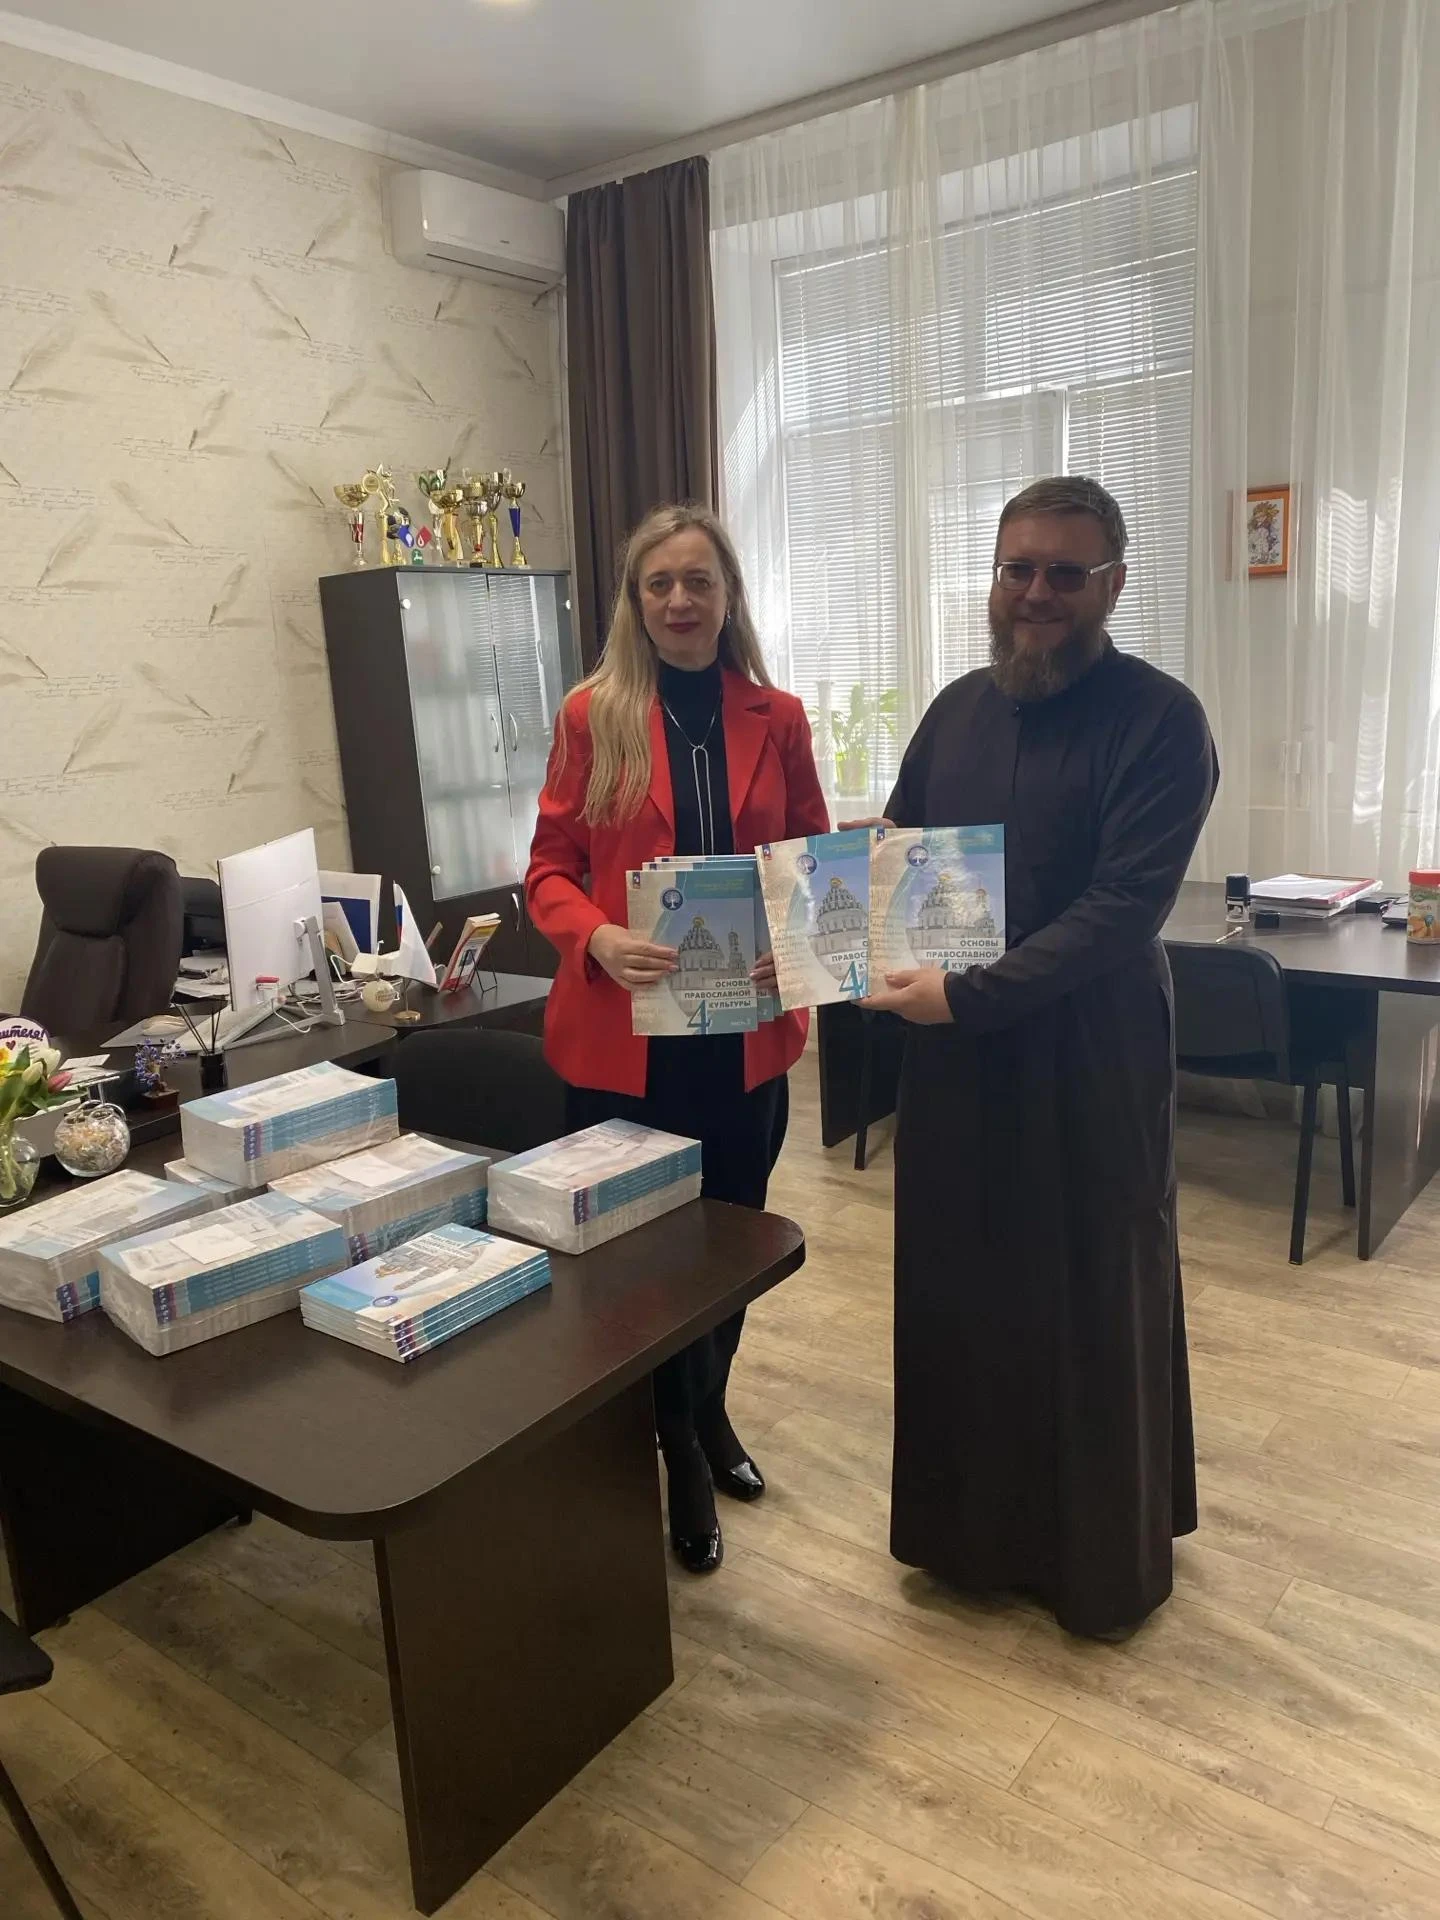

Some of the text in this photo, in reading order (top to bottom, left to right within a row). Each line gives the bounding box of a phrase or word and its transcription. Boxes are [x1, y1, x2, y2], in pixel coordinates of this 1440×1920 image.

[715, 980, 751, 988] ОСНОВЫ
[684, 989, 751, 999] ПРАВОСЛАВНОЙ
[708, 1000, 751, 1009] КУЛЬТУРЫ
[687, 1000, 713, 1034] 4
[0, 1025, 45, 1042] ителя!
